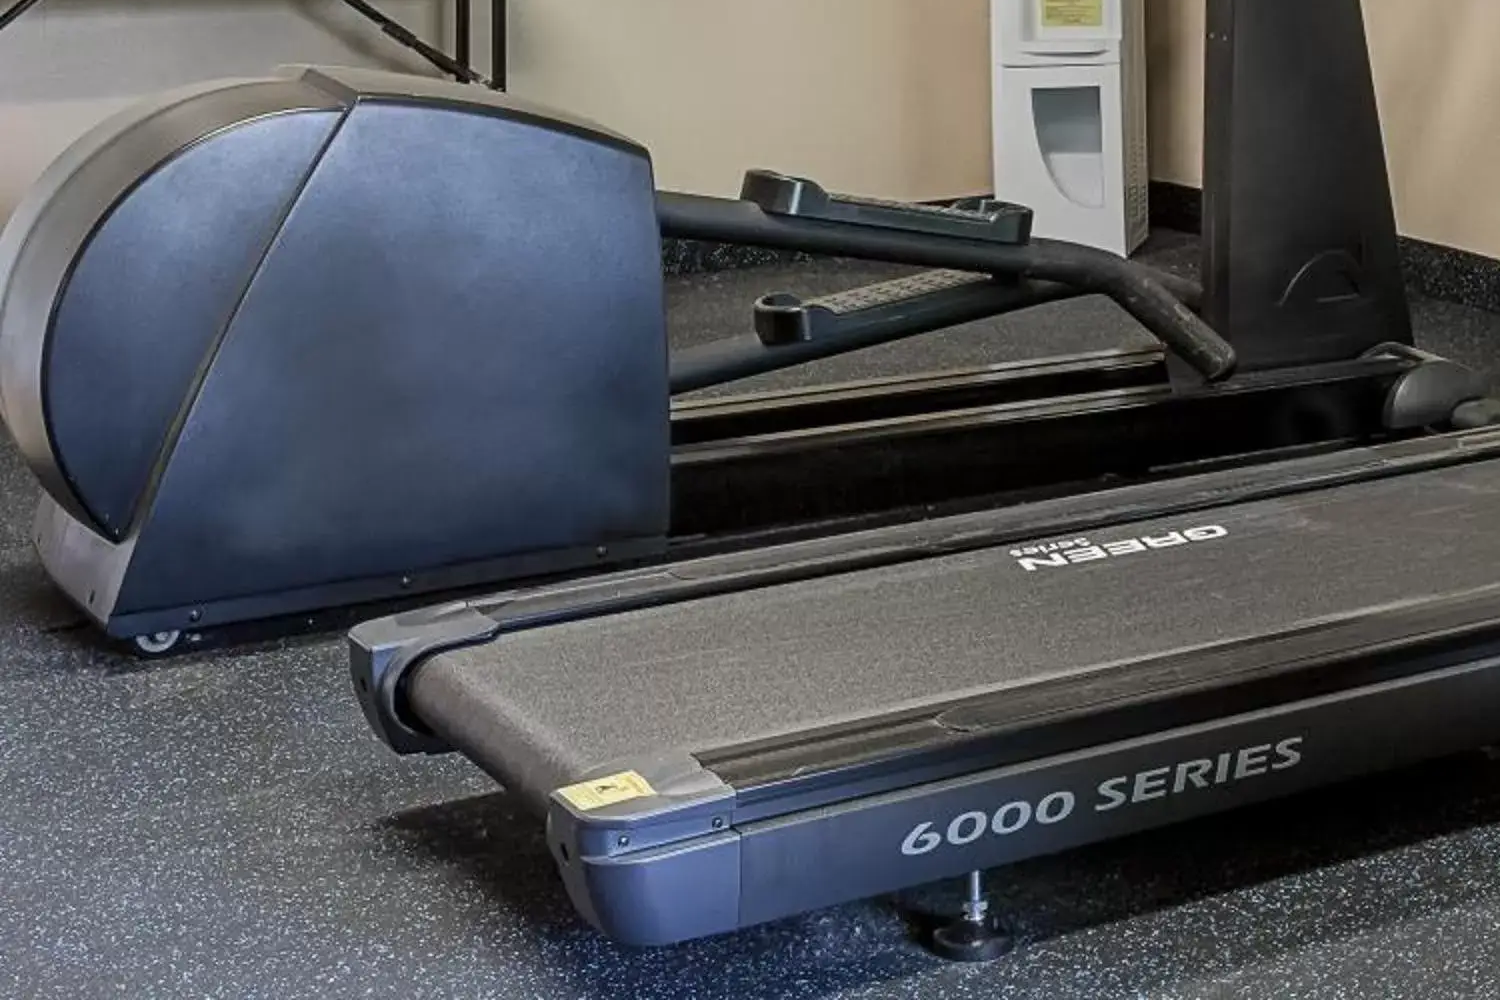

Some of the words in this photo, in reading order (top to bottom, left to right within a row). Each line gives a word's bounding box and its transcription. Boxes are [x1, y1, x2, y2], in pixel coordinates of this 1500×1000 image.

[1017, 525, 1228, 571] GREEN
[901, 791, 1075, 855] 6000
[1093, 736, 1302, 811] SERIES
